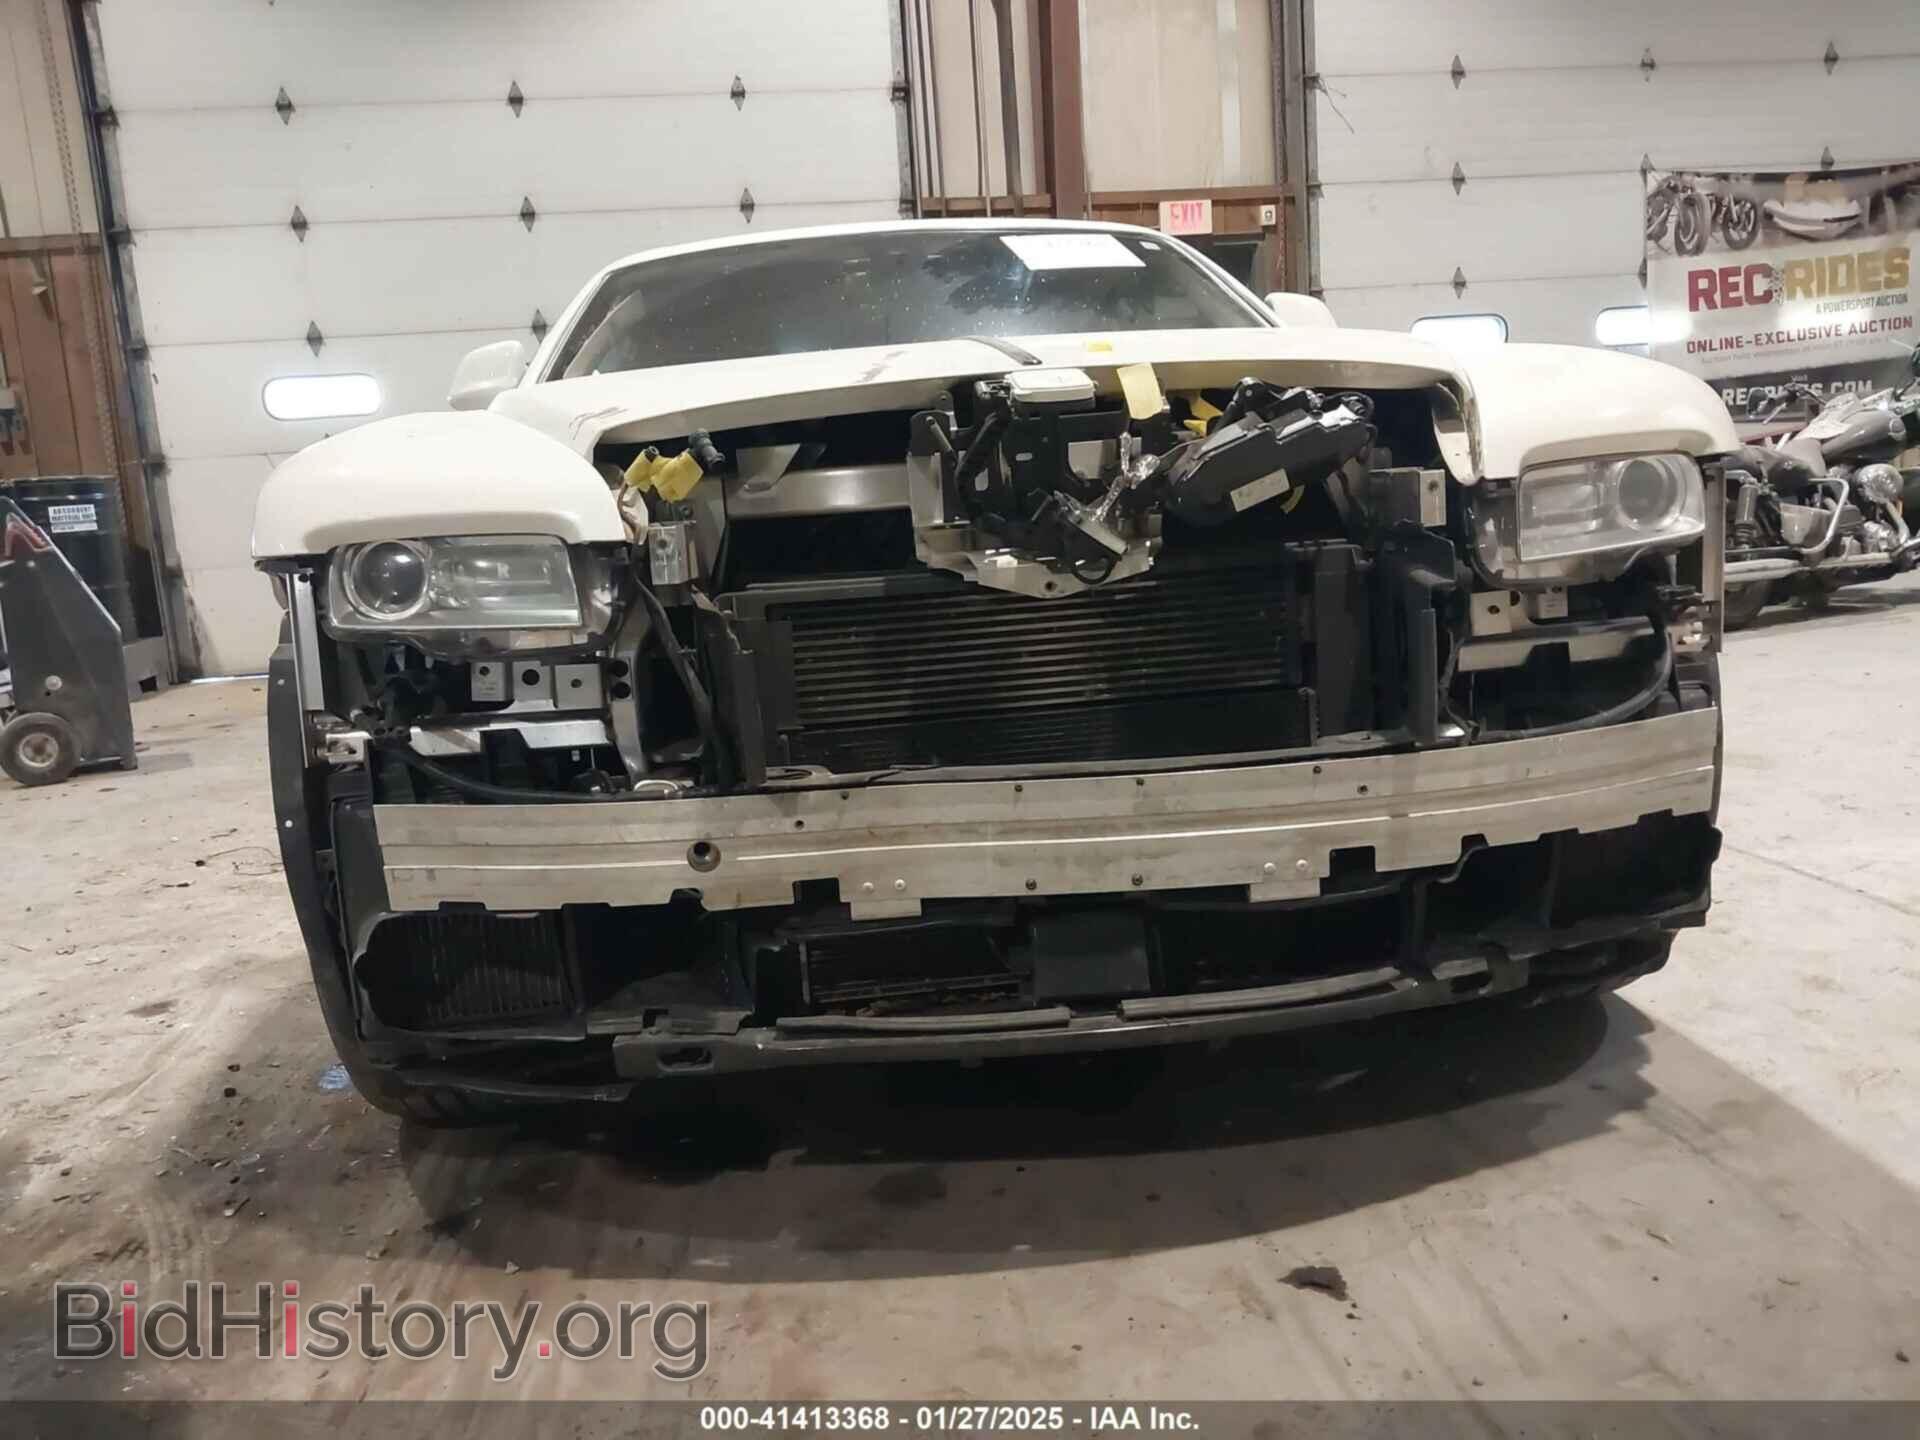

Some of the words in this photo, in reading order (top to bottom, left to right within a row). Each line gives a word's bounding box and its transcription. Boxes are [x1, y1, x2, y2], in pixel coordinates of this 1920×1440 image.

[1169, 202, 1204, 229] EXIT
[1687, 263, 1774, 312] REC
[1785, 248, 1910, 299] RIDES
[1686, 323, 1843, 354] ONLINE-EXCLUSIVE
[1847, 315, 1913, 336] AUCTION
